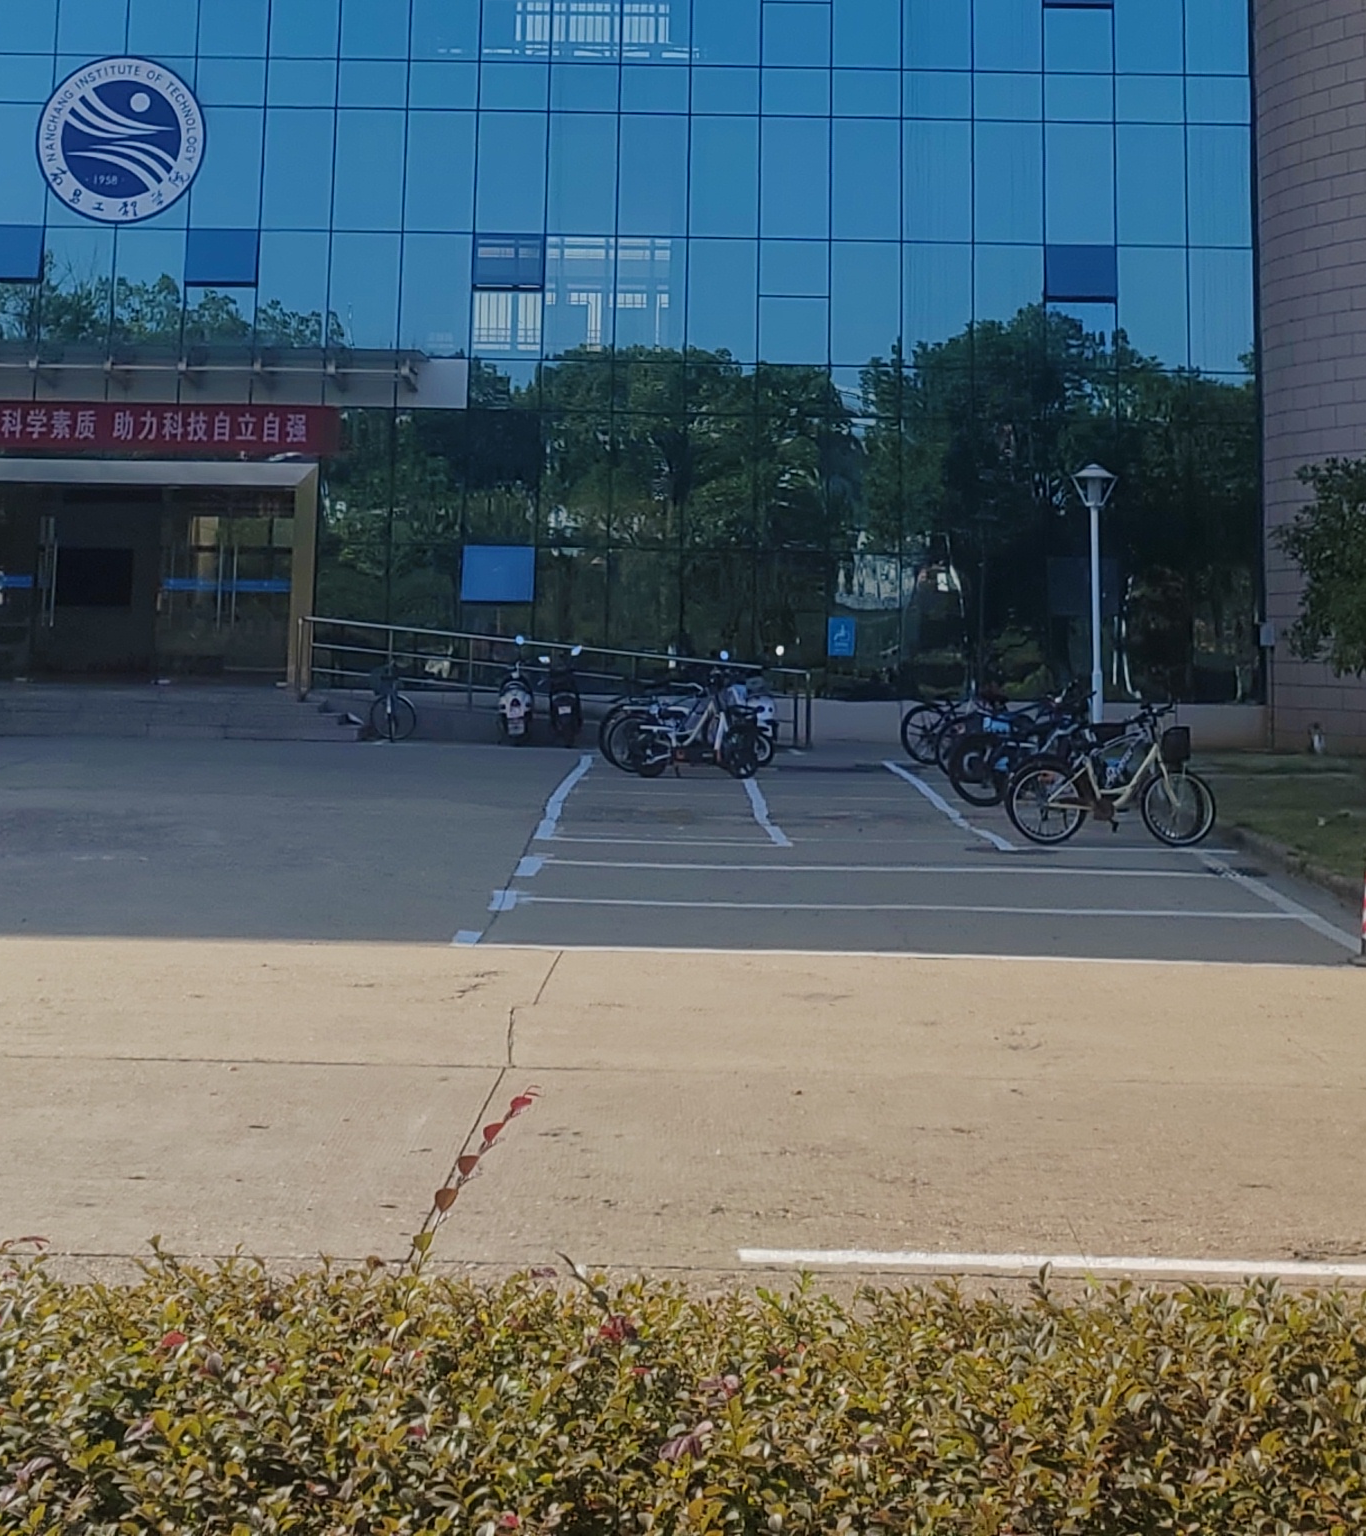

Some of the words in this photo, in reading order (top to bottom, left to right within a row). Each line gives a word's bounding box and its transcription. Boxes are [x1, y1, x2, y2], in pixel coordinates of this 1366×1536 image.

[45, 89, 74, 162] NANCHANG
[74, 64, 142, 90] INSTITUTE
[146, 69, 163, 83] OF
[165, 81, 197, 163] TECHNOLOGY
[92, 174, 118, 185] 1958
[113, 410, 308, 443] 助力科技自立自强
